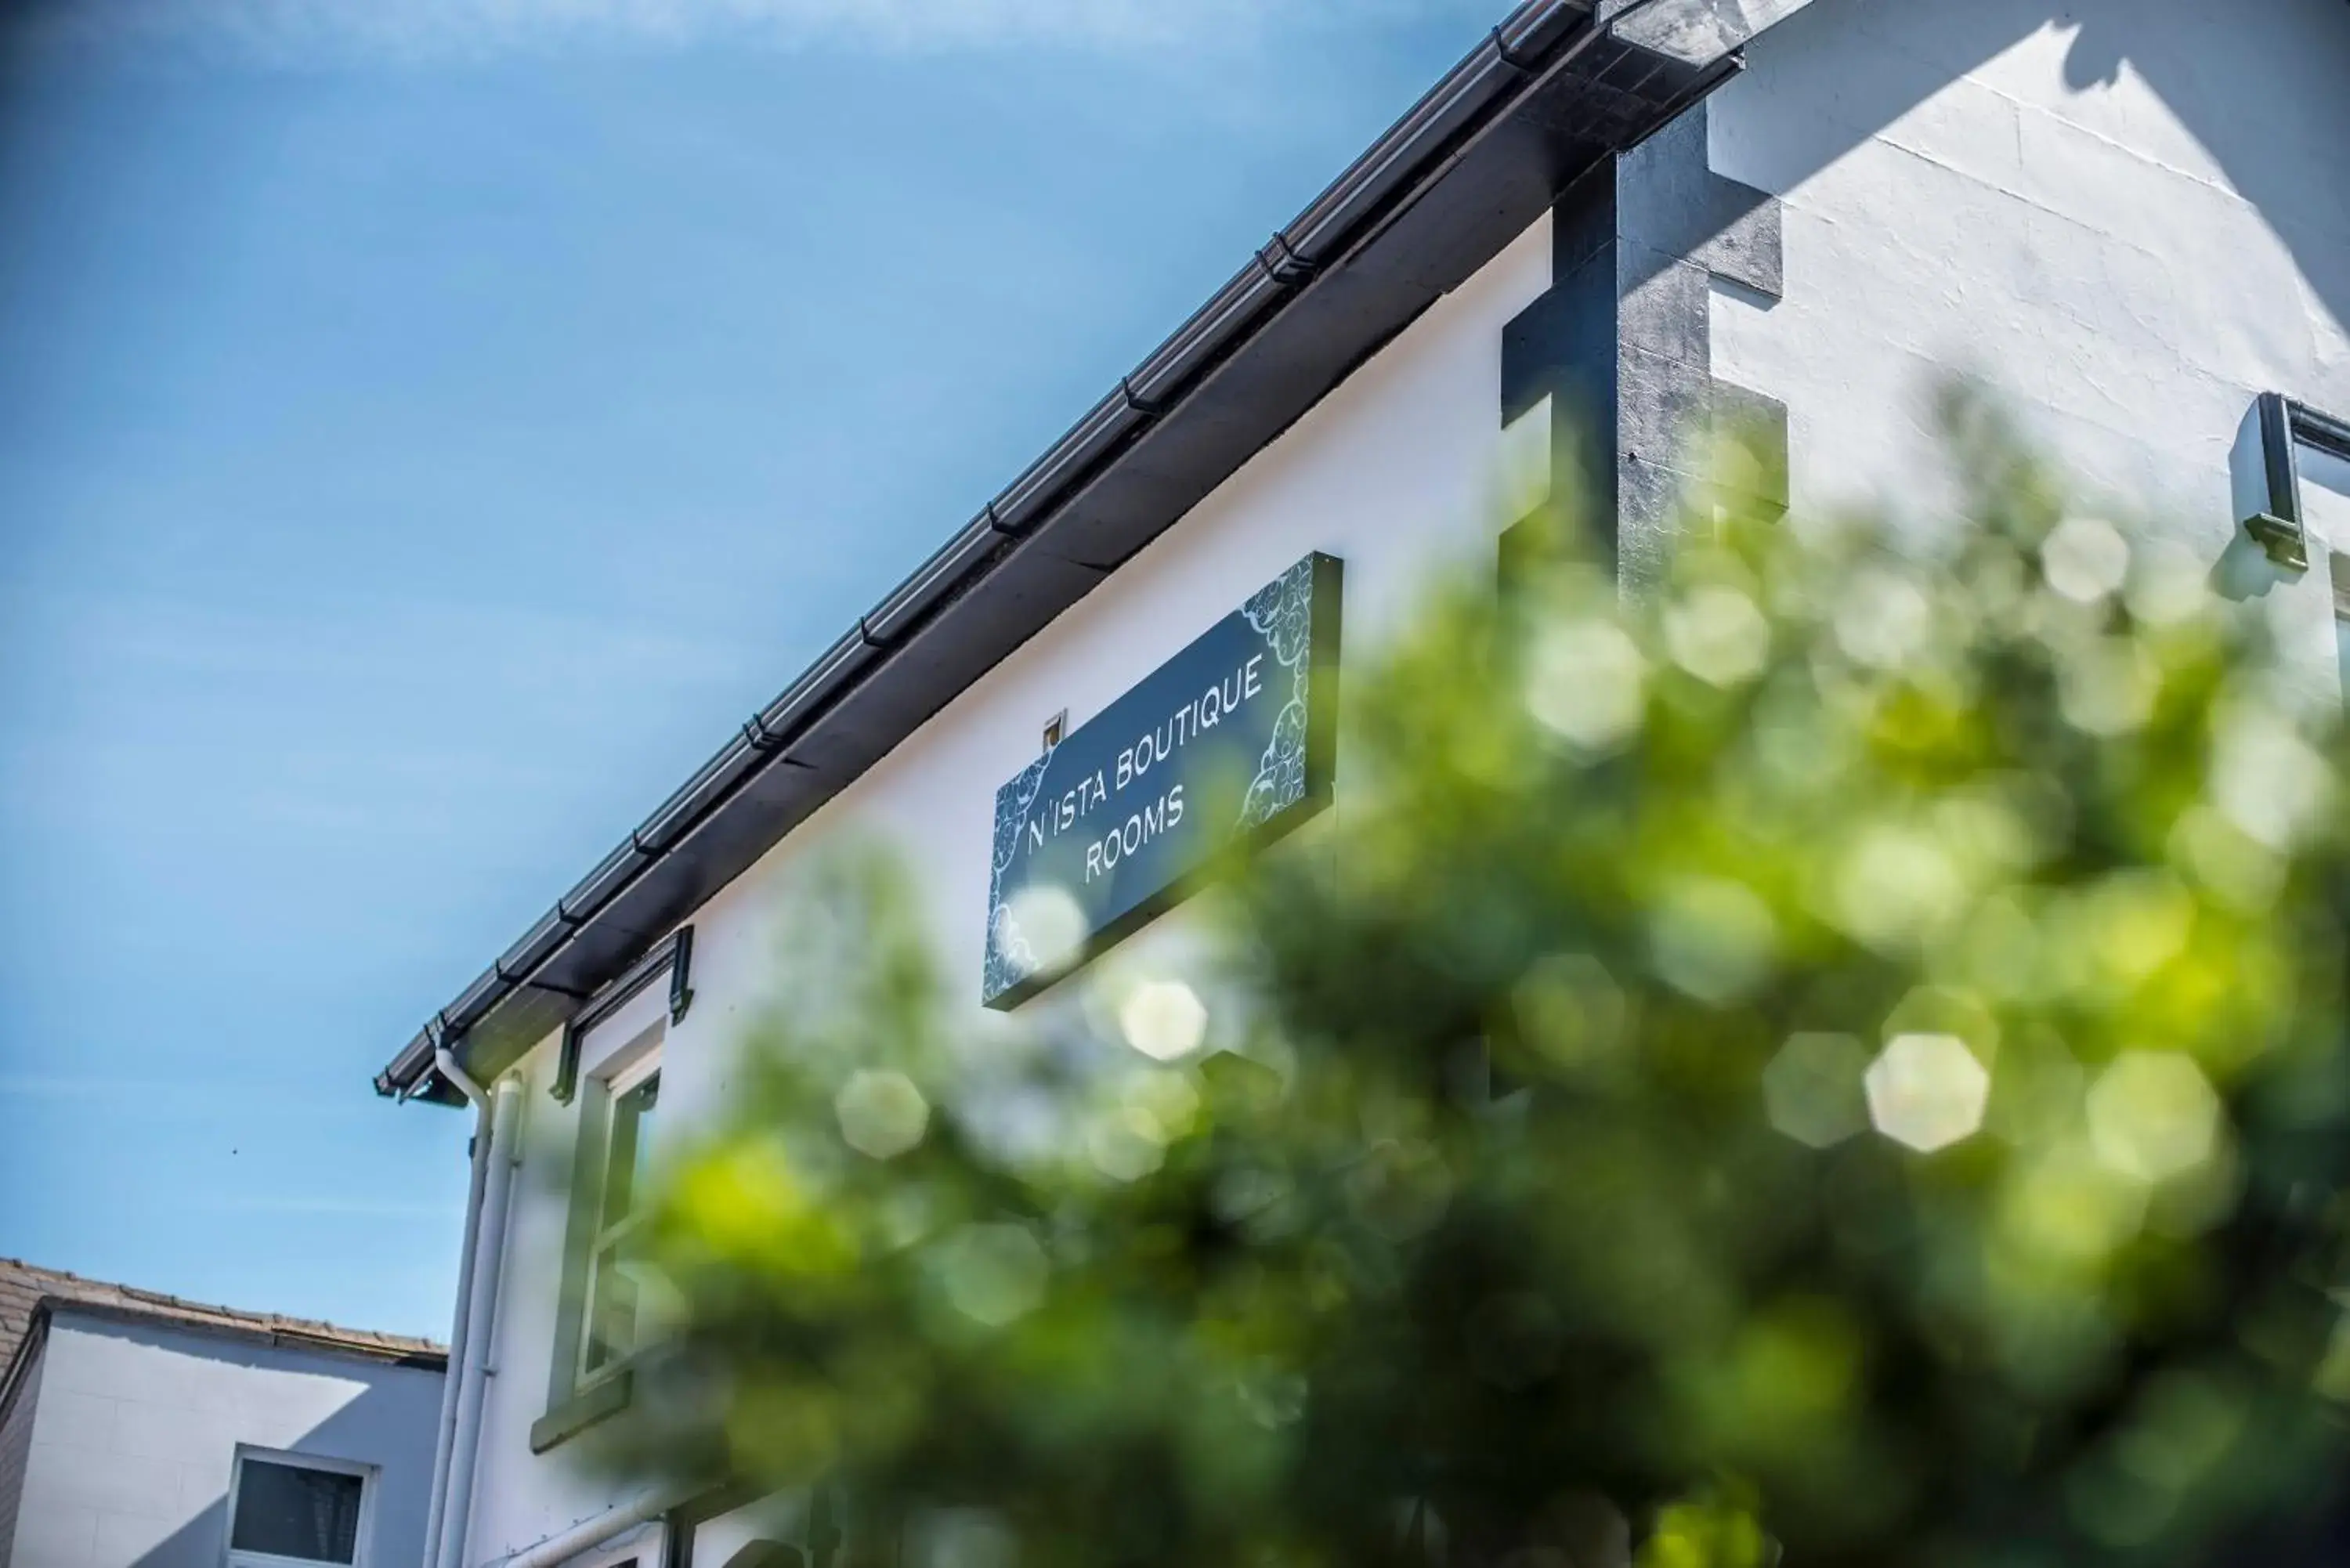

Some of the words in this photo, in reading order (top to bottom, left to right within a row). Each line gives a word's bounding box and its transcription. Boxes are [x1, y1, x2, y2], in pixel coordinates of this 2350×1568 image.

[1028, 768, 1107, 855] N'ISTA
[1115, 654, 1263, 791] BOUTIQUE
[1086, 784, 1184, 883] ROOMS
